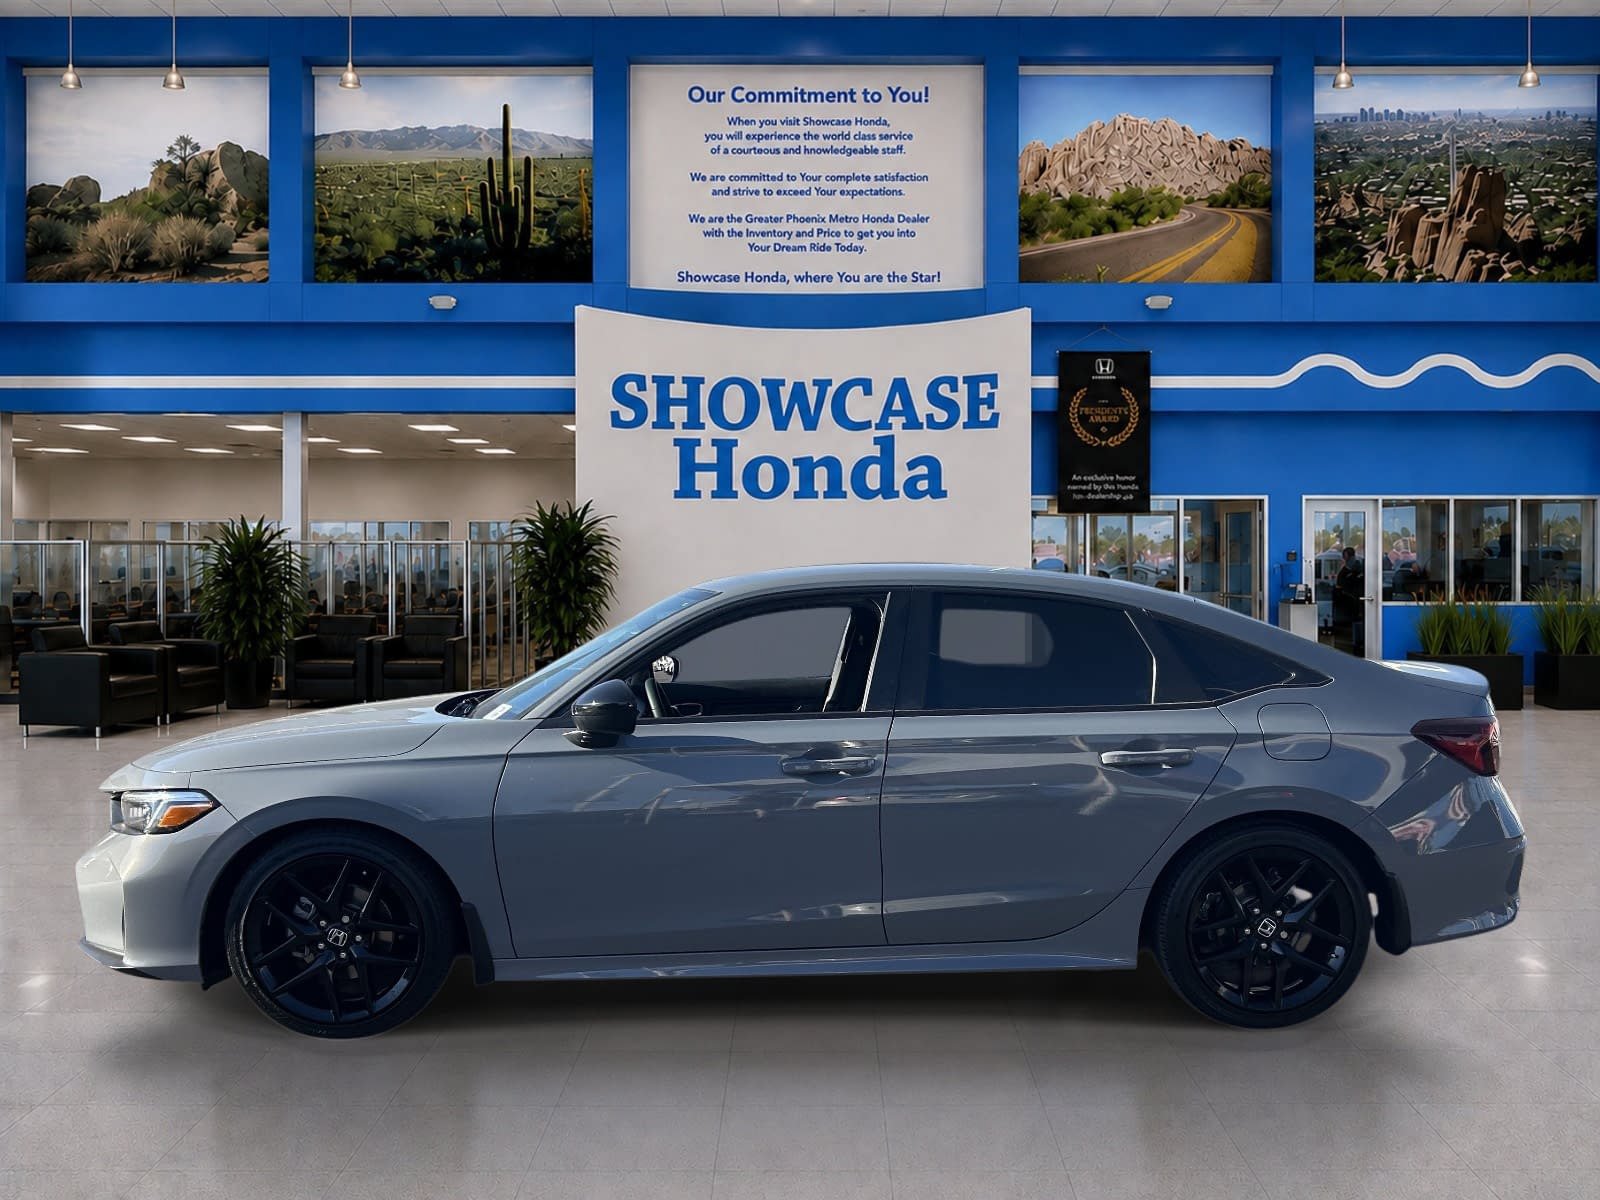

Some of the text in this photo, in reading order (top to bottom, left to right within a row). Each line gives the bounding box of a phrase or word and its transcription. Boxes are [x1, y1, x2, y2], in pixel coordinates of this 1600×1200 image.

[687, 85, 930, 104] Our Commitment to You!
[726, 116, 891, 129] When you visit Showcase Honda,
[704, 130, 914, 144] you will experience the world class service
[710, 144, 721, 155] of
[722, 147, 730, 155] a
[730, 146, 782, 156] courteous
[782, 144, 802, 155] and
[881, 144, 906, 155] staff.
[689, 171, 929, 184] We are committed to Your complete satisfaction
[711, 186, 905, 199] and strive to exceed Your expectations.
[688, 213, 931, 224] We are the Greater Phoenix Metro Honda Dealer
[702, 227, 917, 241] with the Inventory and Price to get you into
[747, 242, 867, 255] Your Dream Ride Today.
[677, 270, 941, 286] Showcase Honda, where You are the Star!
[610, 373, 1001, 431] SHOWCASE
[672, 434, 948, 500] Honda
